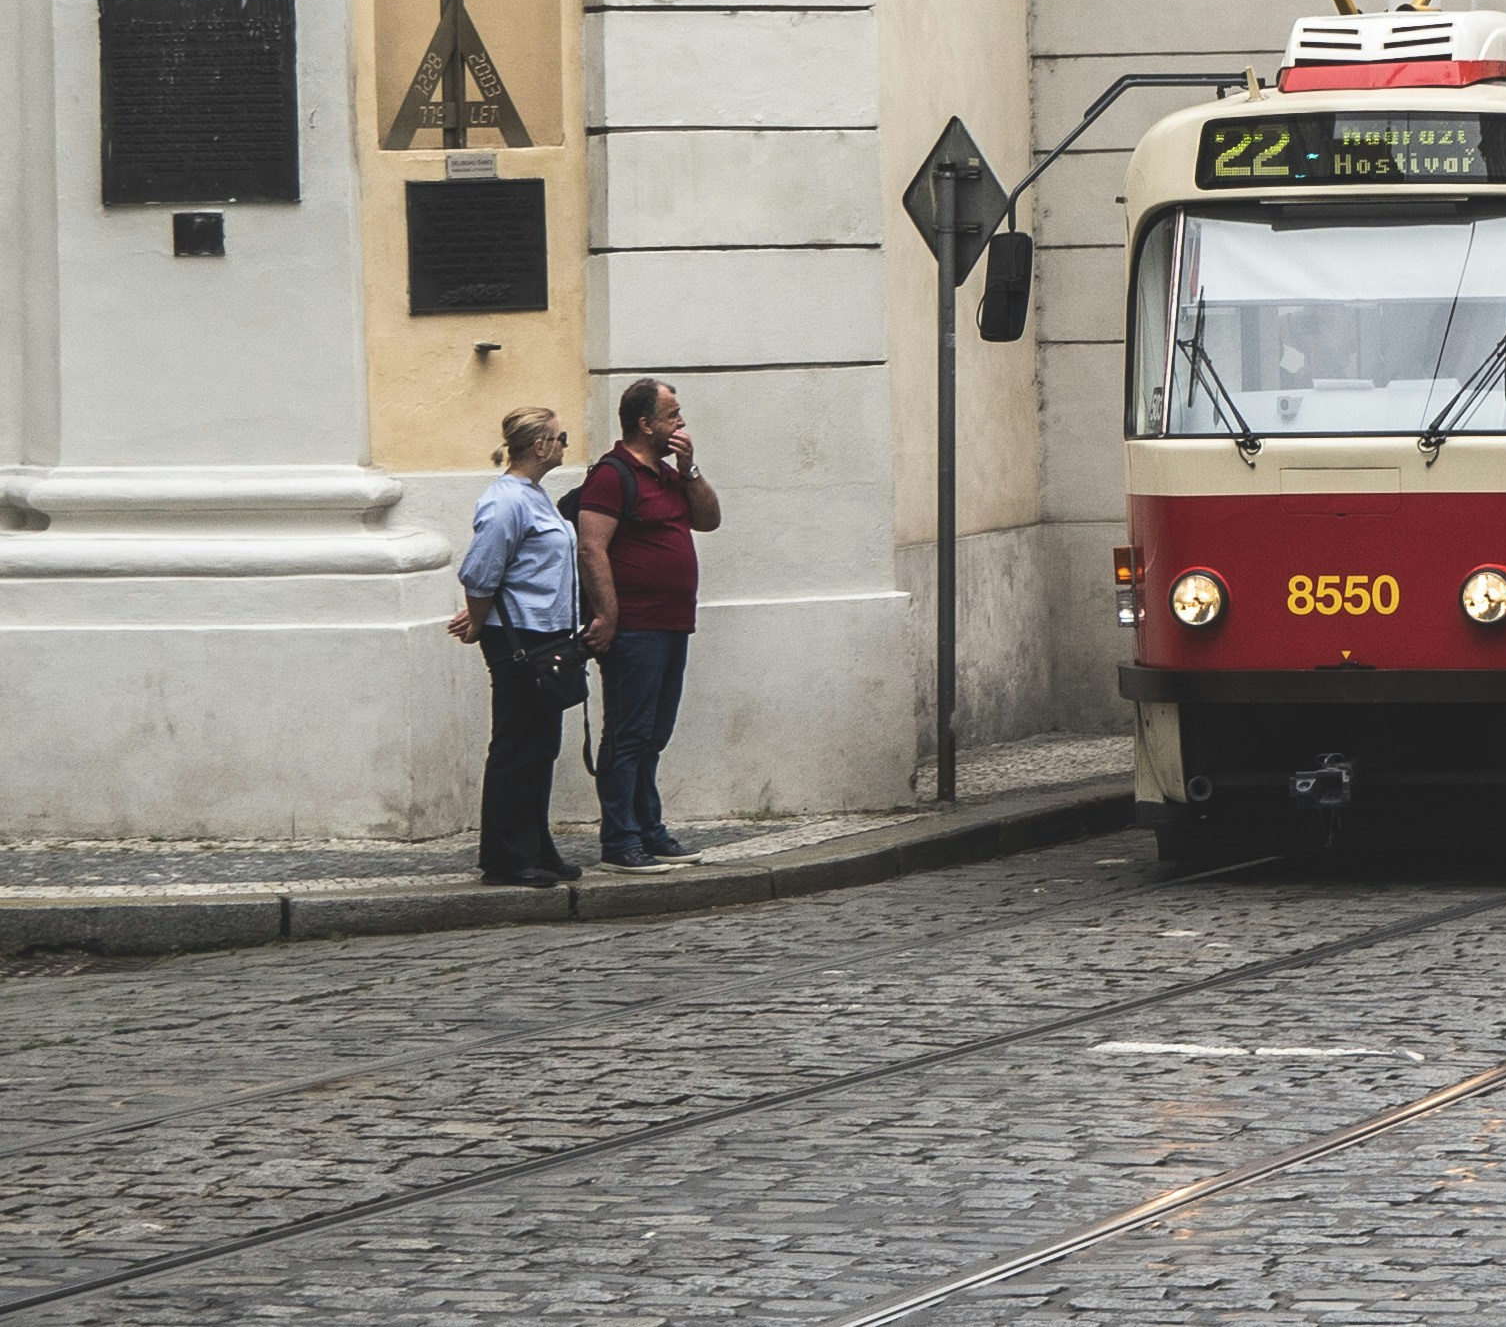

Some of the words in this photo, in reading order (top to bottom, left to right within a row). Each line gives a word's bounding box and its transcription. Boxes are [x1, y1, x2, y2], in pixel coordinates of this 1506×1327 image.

[414, 52, 443, 95] 1228
[468, 53, 502, 98] 2003
[469, 105, 499, 124] LET
[1215, 125, 1290, 176] 22
[1334, 148, 1475, 174] Hostivař
[1287, 574, 1400, 615] 8550
